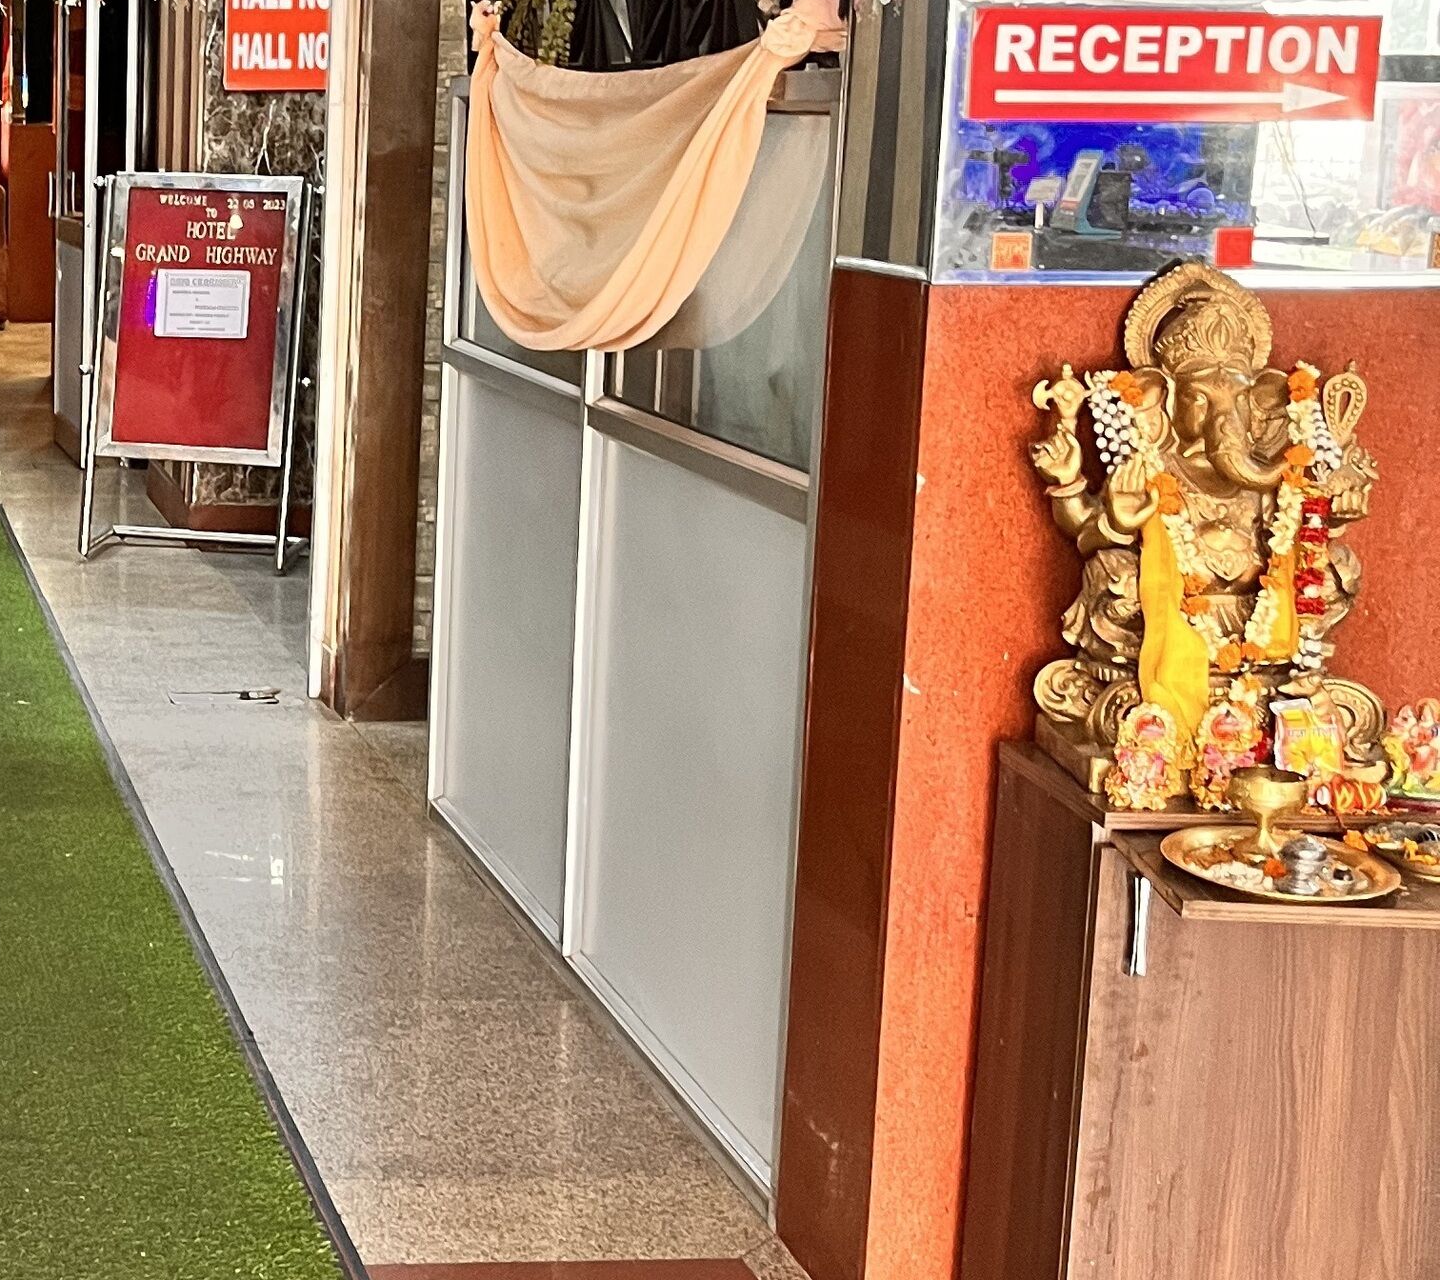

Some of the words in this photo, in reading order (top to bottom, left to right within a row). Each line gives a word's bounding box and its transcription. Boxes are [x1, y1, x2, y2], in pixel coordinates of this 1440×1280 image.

[231, 32, 292, 70] HALL
[298, 32, 329, 70] NO
[994, 23, 1359, 74] RECEPTION
[159, 194, 207, 206] WELCOME
[205, 207, 218, 218] TO
[186, 221, 236, 239] HOTEL
[135, 243, 190, 263] GRAND
[206, 246, 277, 265] HIGHWAY
